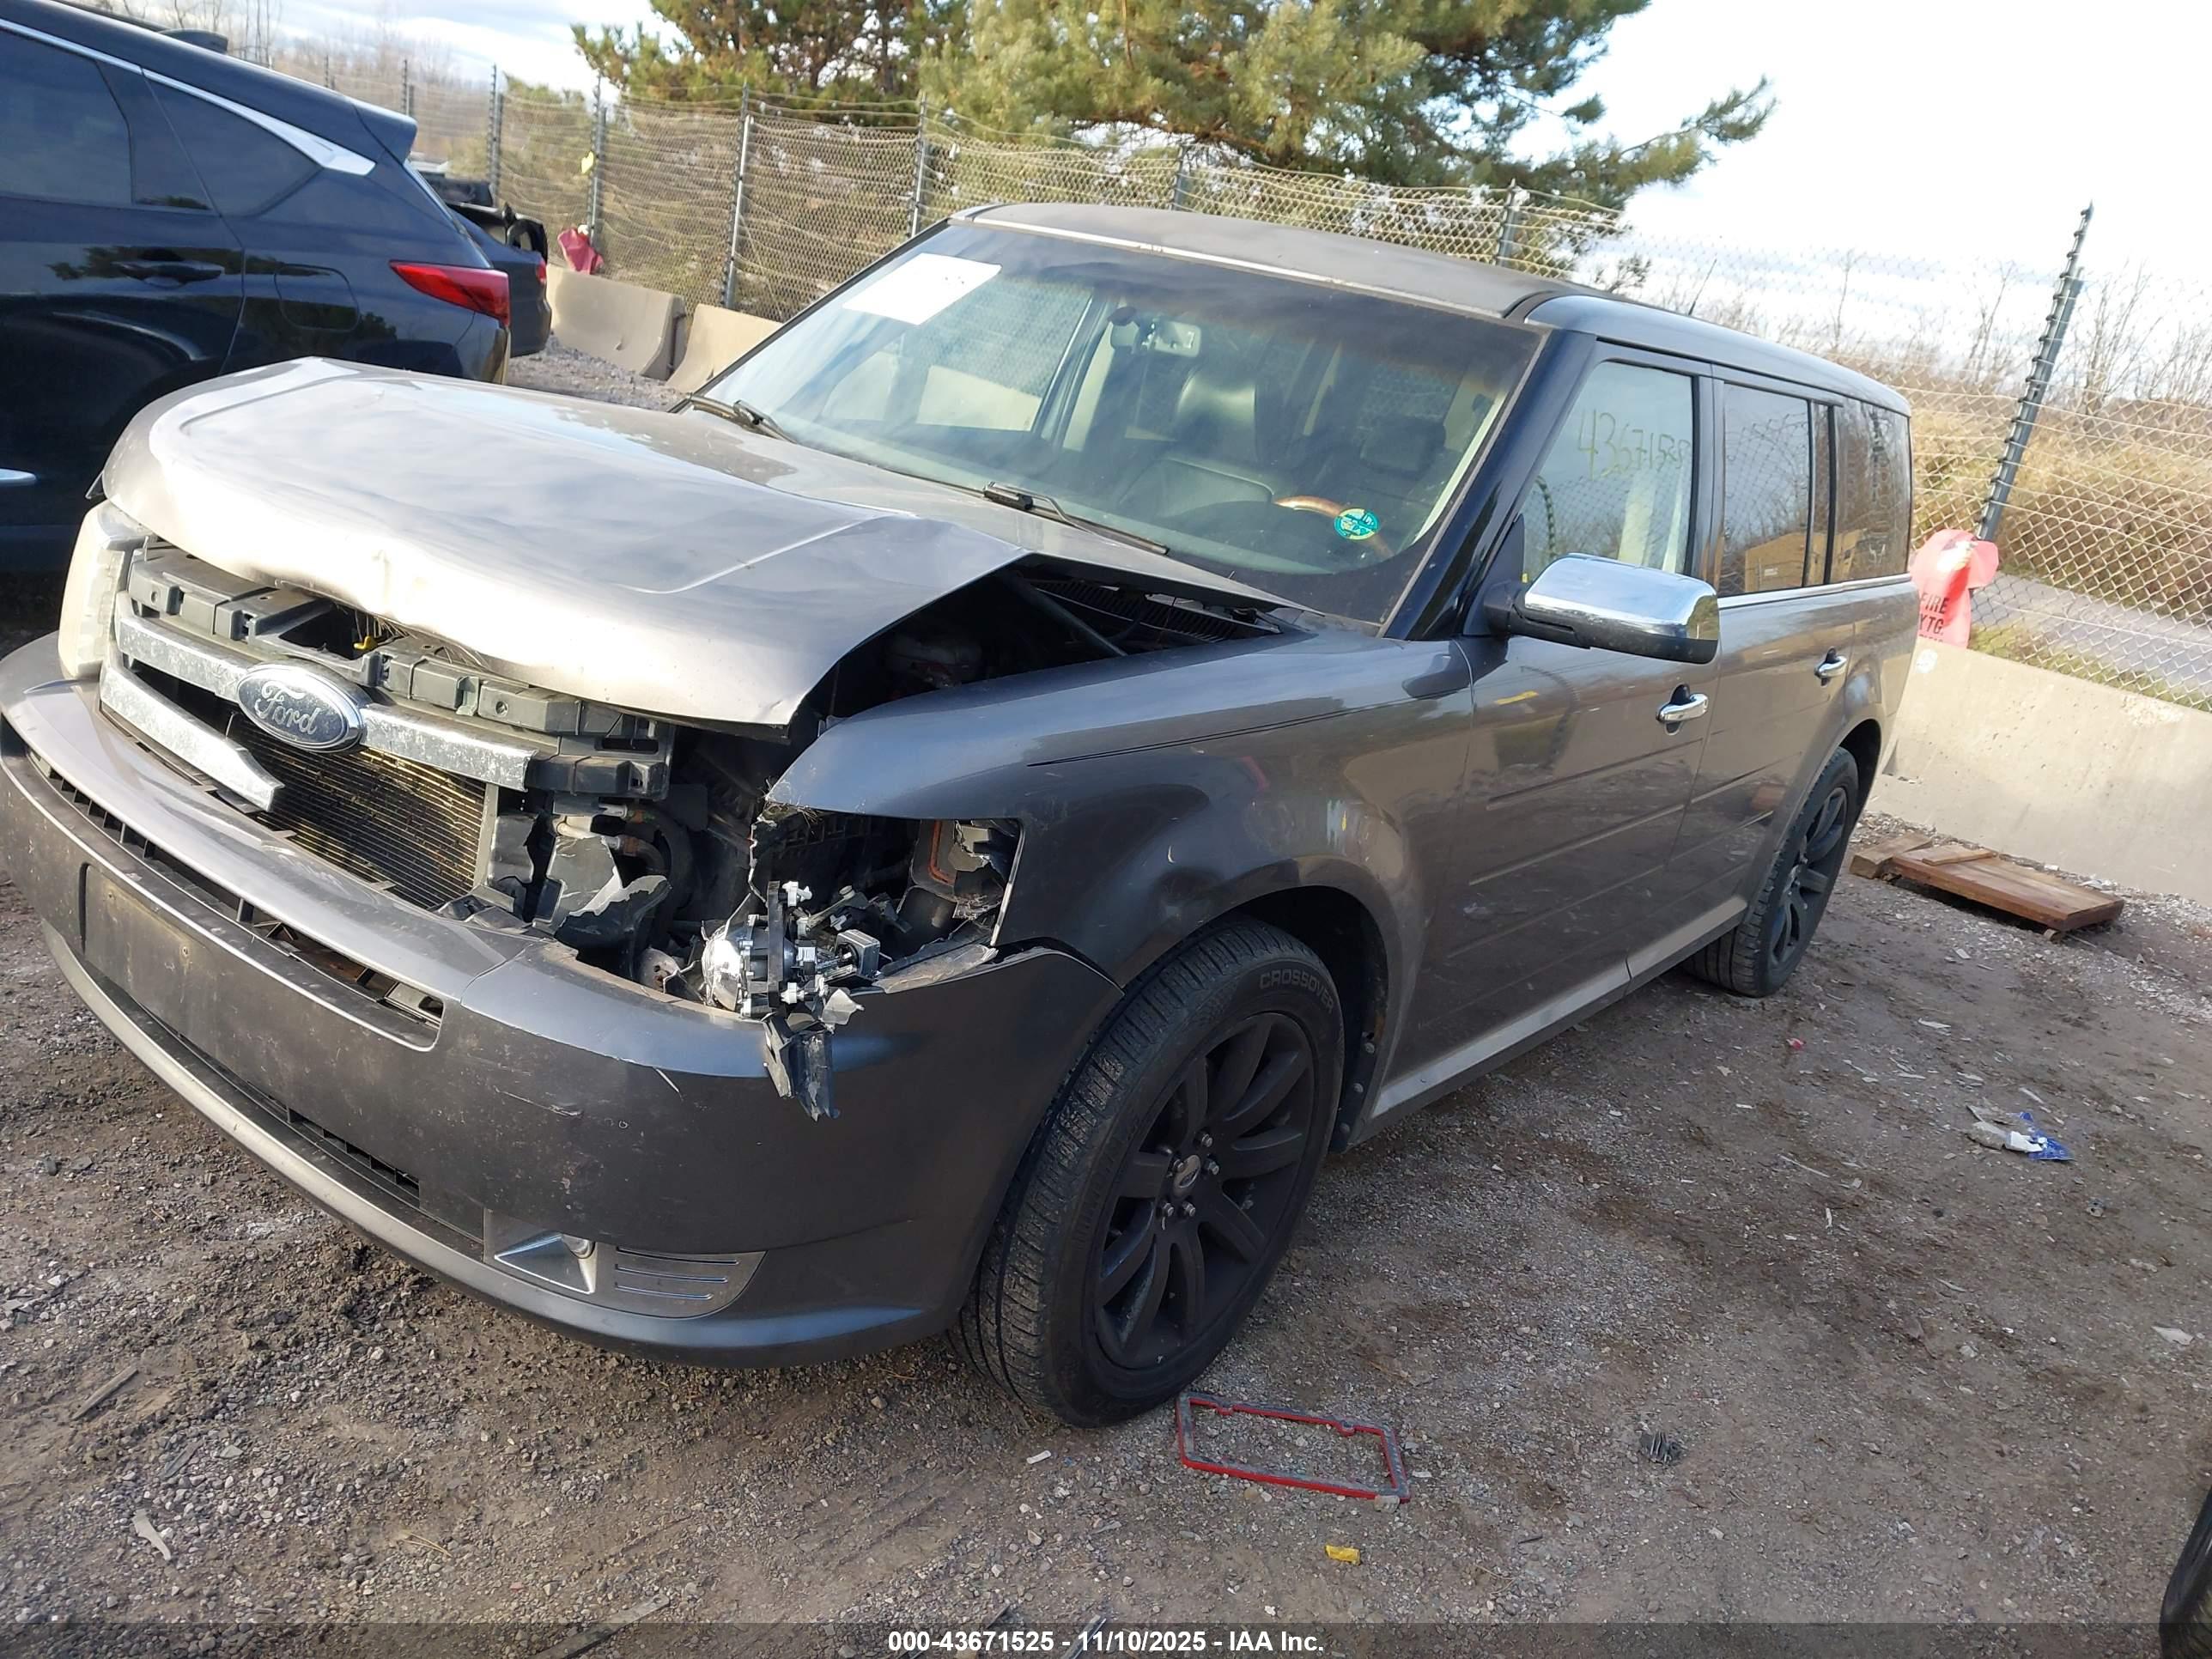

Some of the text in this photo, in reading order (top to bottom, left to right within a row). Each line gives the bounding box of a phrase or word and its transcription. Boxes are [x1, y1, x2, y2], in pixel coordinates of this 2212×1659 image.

[1919, 592, 1950, 616] FIRE
[255, 681, 320, 734] Ford
[1260, 969, 1334, 1014] CROSSOVER
